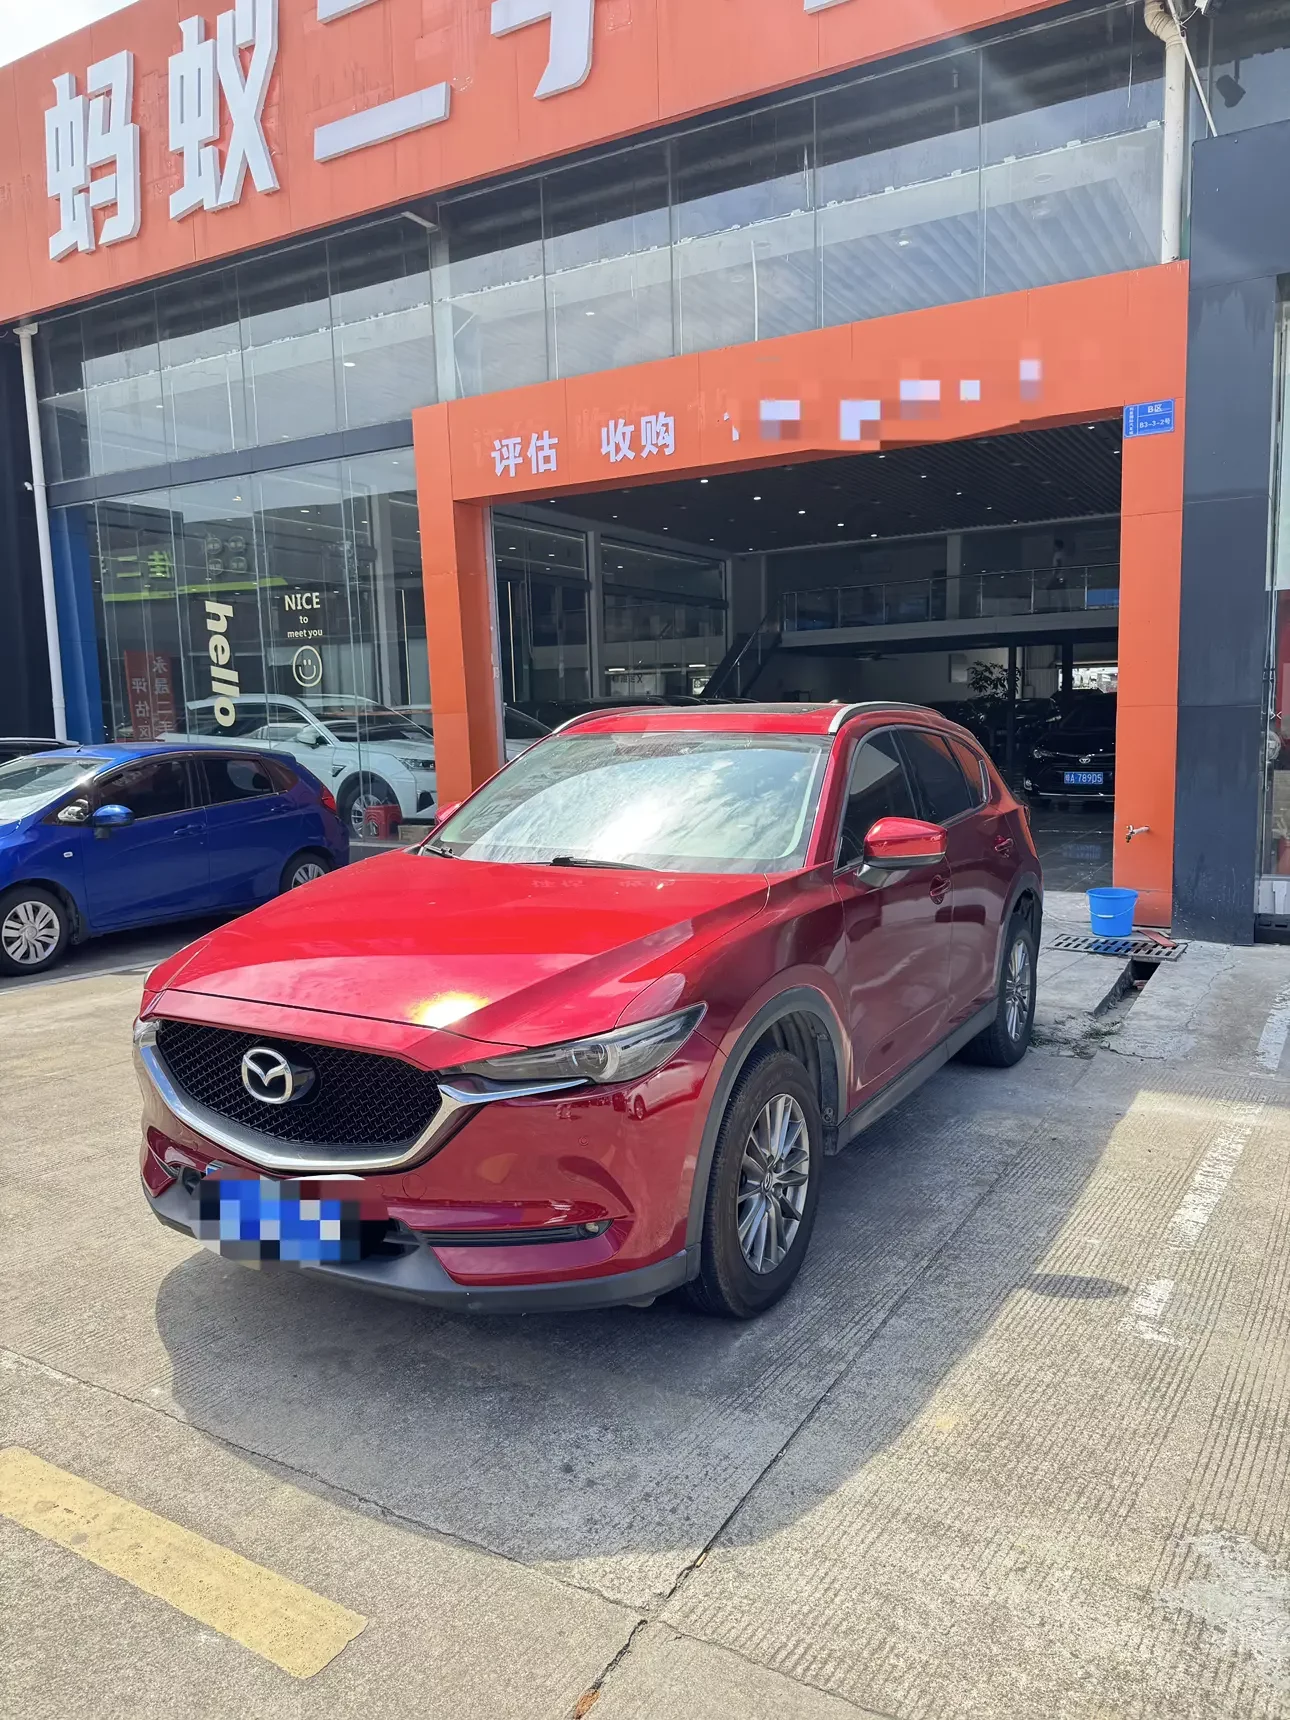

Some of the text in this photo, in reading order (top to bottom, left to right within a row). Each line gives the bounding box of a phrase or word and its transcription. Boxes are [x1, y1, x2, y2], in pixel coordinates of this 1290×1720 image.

[490, 411, 675, 478] 评估 收购
[284, 592, 321, 611] NICE
[299, 615, 309, 624] to
[287, 628, 323, 639] meet you
[204, 600, 241, 727] hello
